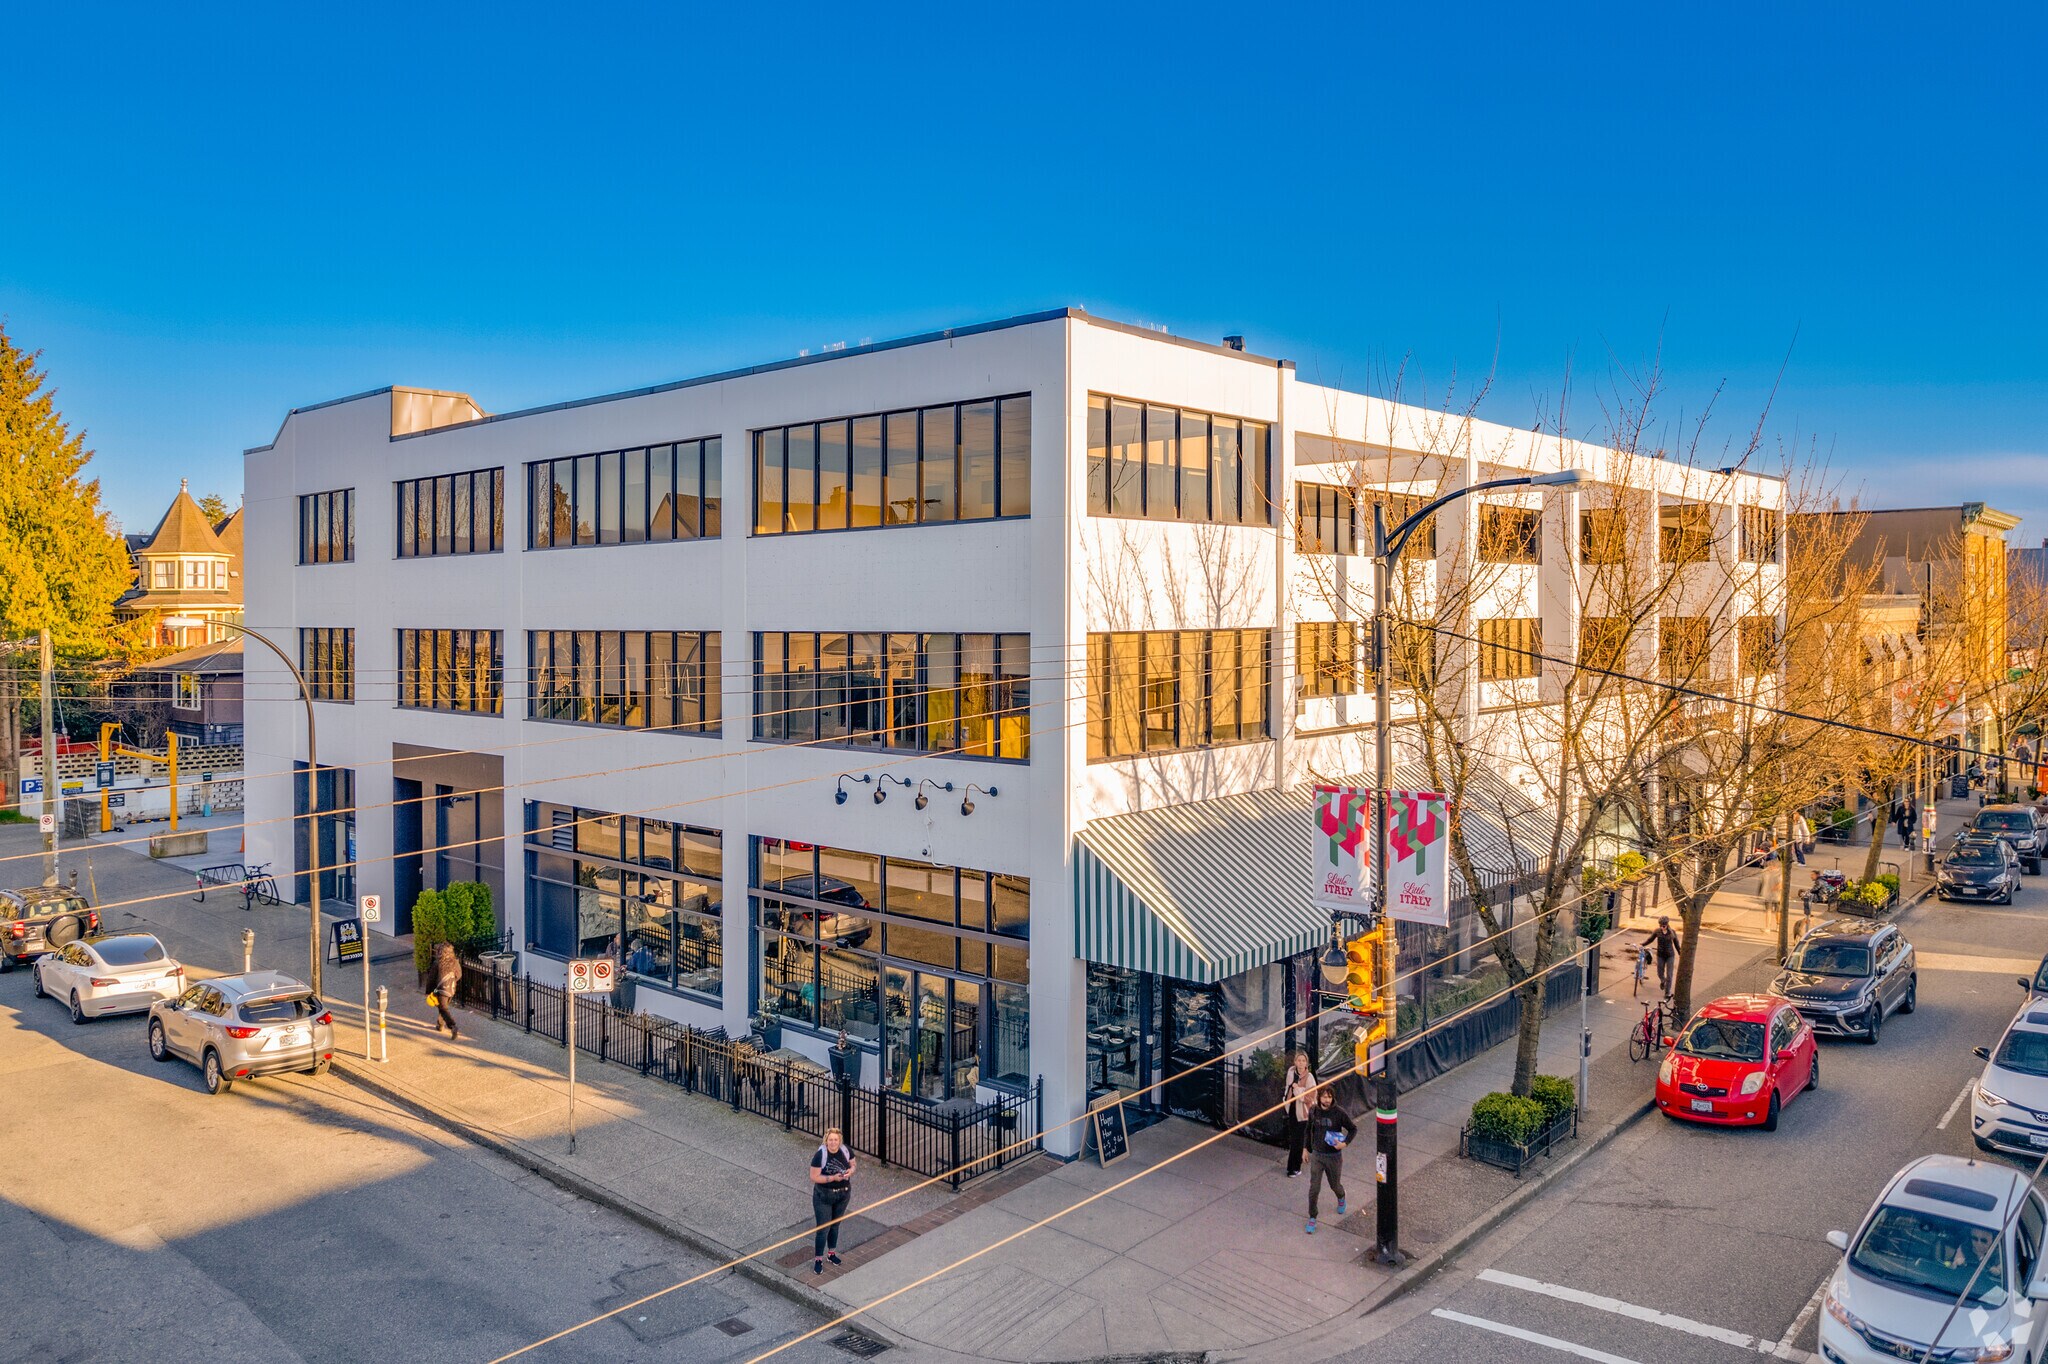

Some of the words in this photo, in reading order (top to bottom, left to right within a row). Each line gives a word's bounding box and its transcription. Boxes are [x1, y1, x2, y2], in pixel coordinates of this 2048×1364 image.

[25, 781, 35, 792] P
[1326, 872, 1351, 886] Little
[1324, 884, 1353, 897] ITALY
[1403, 881, 1430, 896] Little
[1399, 894, 1432, 907] ITALY
